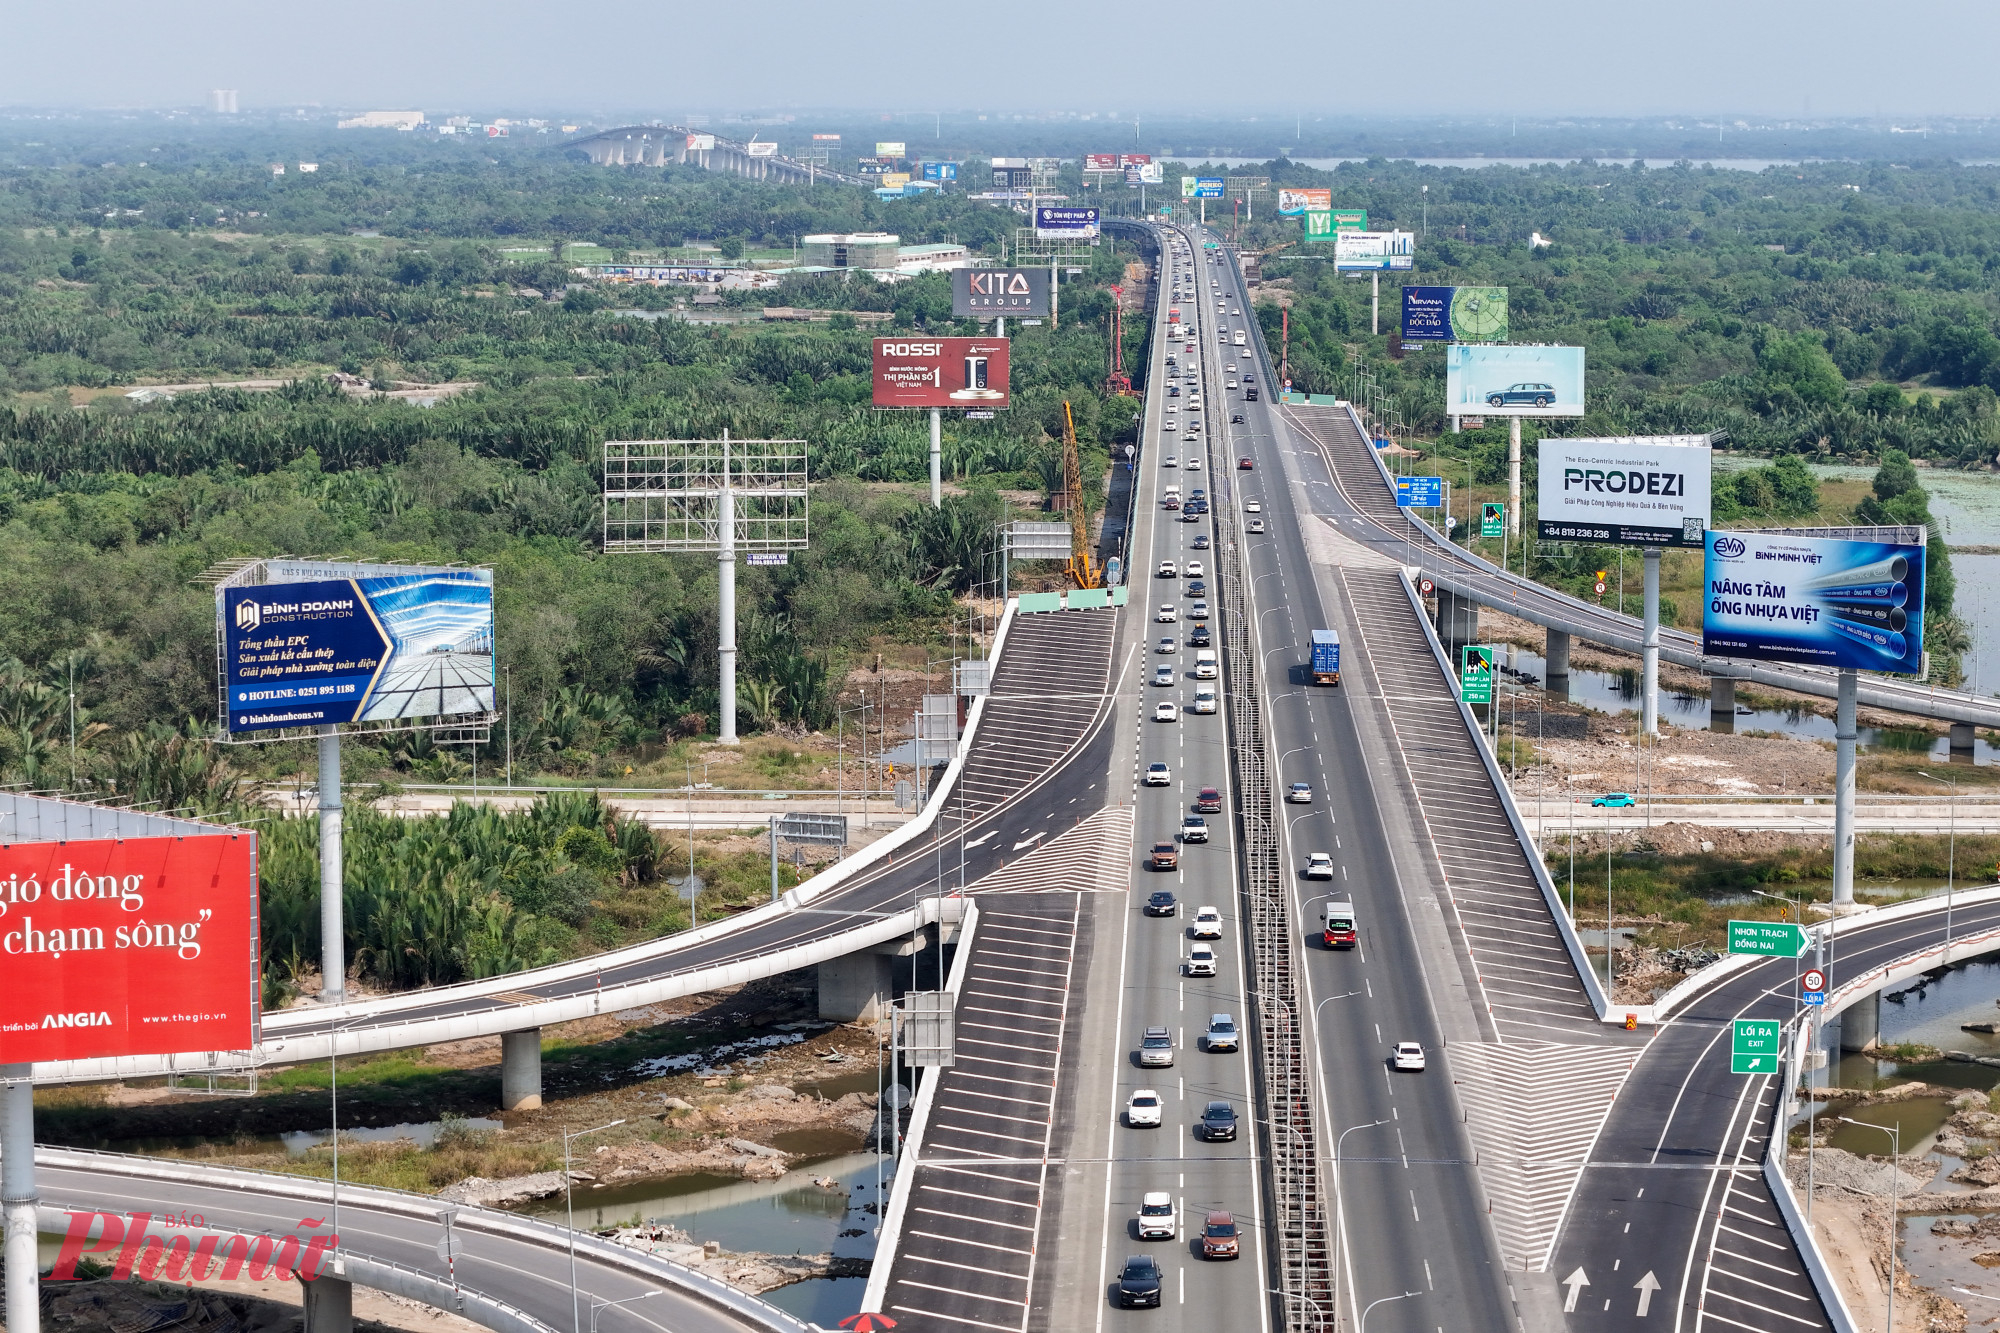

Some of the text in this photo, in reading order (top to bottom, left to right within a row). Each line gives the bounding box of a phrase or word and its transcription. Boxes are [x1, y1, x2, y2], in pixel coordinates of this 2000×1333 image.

[970, 273, 1030, 295] KITA
[1408, 295, 1443, 304] NIRVANA
[882, 344, 940, 356] ROSSI
[883, 366, 940, 387] THỊ PHẦN SỐ 1
[1564, 469, 1684, 496] PRODEZI
[1591, 499, 1604, 507] Công
[1606, 500, 1625, 508] Nghiệp
[1658, 502, 1667, 510] Bền
[1545, 527, 1609, 538] +84 819 236 236
[1802, 553, 1822, 565] VIỆT
[1712, 578, 1786, 599] NÂNG TẦM
[263, 600, 353, 615] BÌNH DOANH
[1711, 597, 1820, 624] ỐNG NHỰA VIỆT
[263, 610, 353, 623] CONSTRUCTION
[239, 635, 309, 652] Tổng thầu EPC
[1759, 644, 1836, 656] www.binhminhvietplastic.com.vn
[238, 647, 334, 664] Sản xuất kết cấu thép
[240, 658, 376, 679] Giải pháp nhà xưởng toàn diện
[249, 684, 355, 701] HOTLINE: 0251 895 1188
[250, 710, 324, 724] binhdoanhcons.vn
[52, 864, 144, 912] đông
[4, 916, 106, 959] chạm
[1735, 928, 1788, 938] NHƠN TRẠCH
[1735, 940, 1757, 949] ĐỒNG
[1808, 976, 1820, 986] 50
[25, 1021, 38, 1031] bởi
[41, 1012, 112, 1029] ANGIA
[143, 1012, 227, 1023] www.thegio.vn
[1740, 1025, 1772, 1036] LỐI RA
